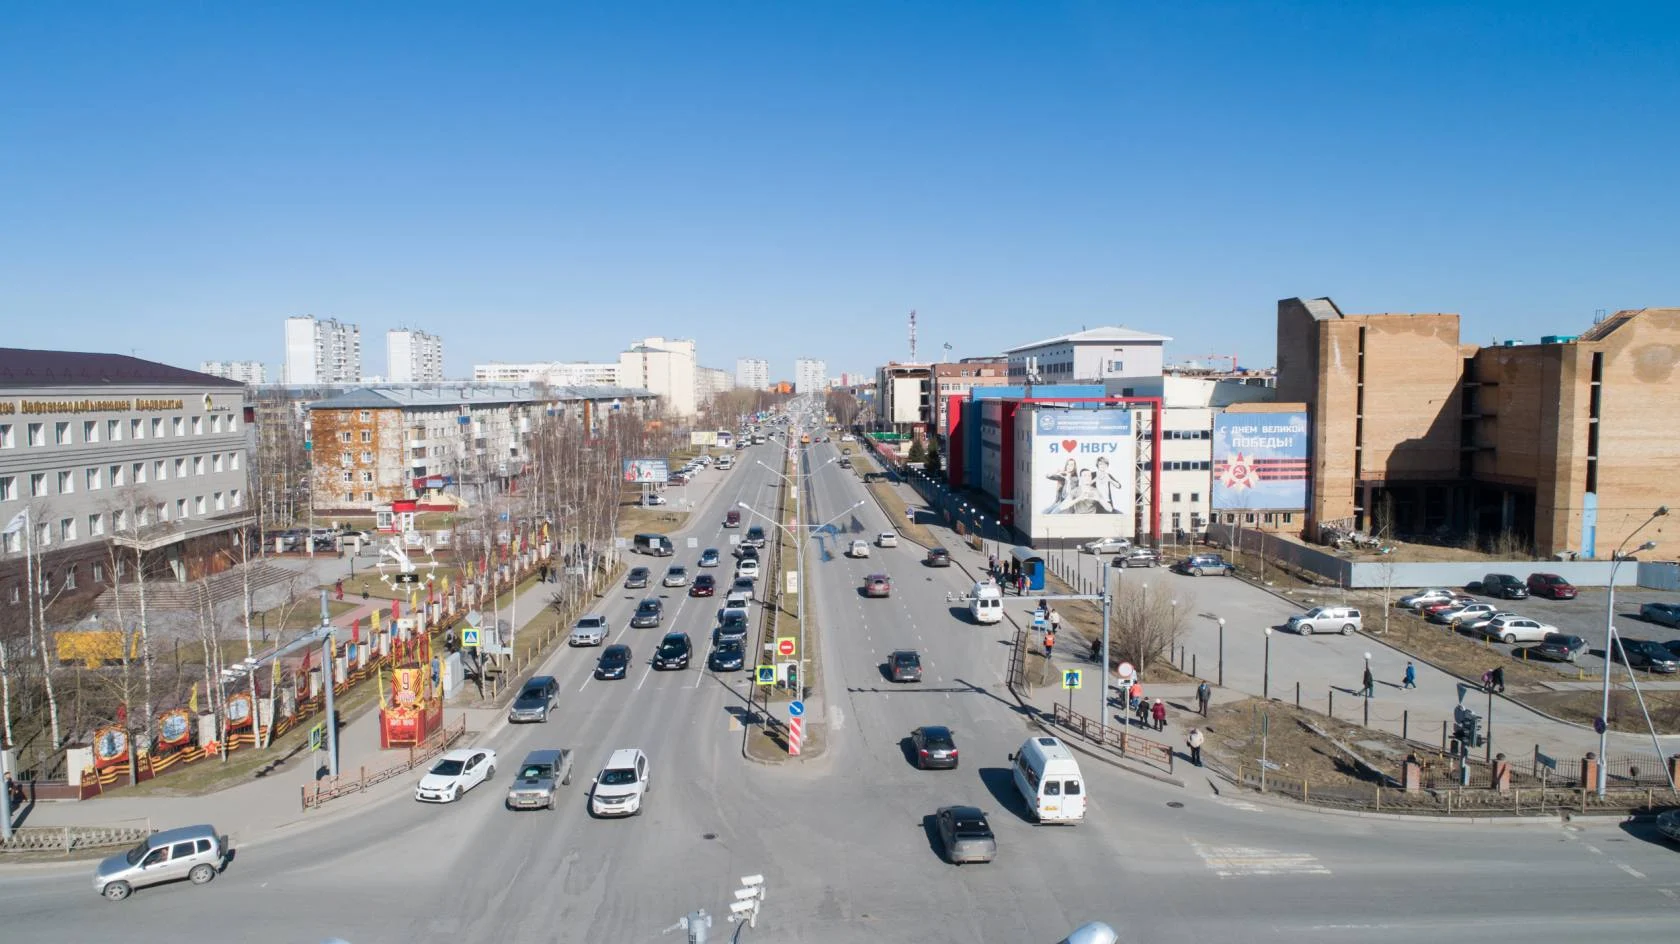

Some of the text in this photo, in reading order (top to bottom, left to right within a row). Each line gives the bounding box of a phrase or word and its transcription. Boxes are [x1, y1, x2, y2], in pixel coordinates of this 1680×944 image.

[1220, 424, 1305, 434] С ДНЕМ ВЕЛИКОЙ
[1049, 442, 1118, 453] Я НВГУ
[1232, 437, 1293, 448] ПОБЕДЫ!
[402, 672, 410, 690] 9
